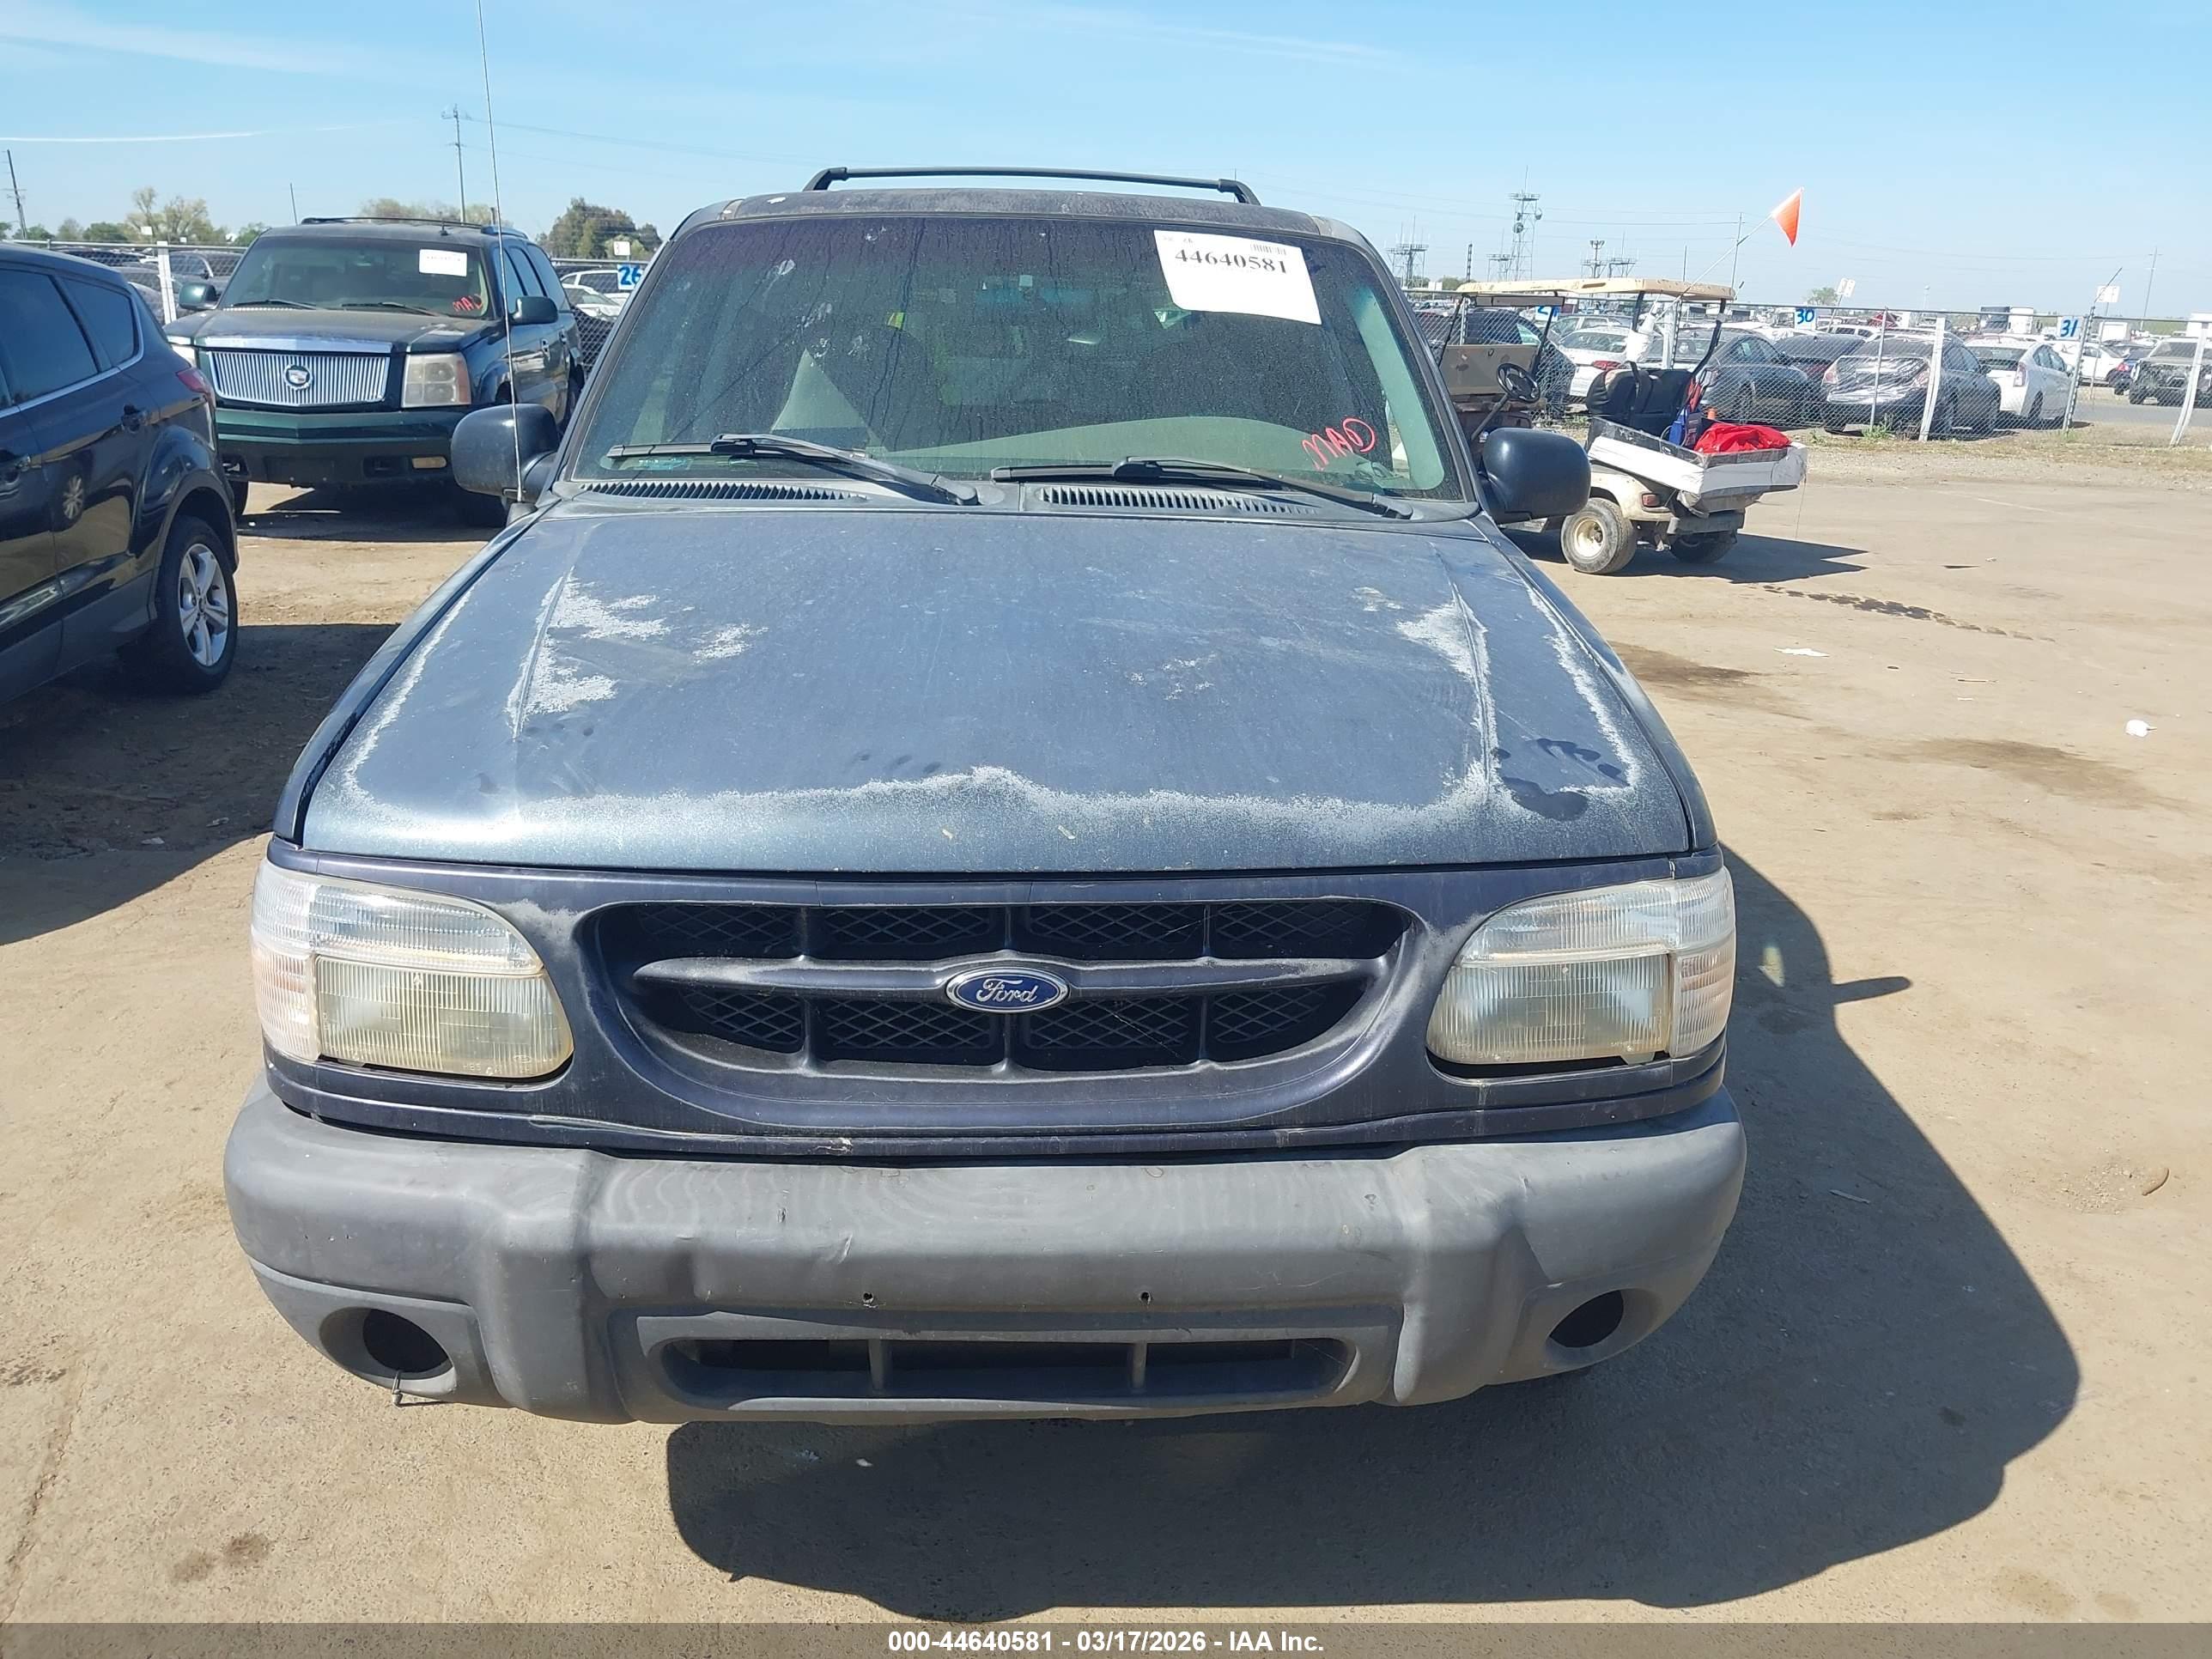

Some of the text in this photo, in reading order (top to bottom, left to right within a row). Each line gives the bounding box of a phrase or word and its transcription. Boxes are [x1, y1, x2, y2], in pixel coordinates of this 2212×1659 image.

[1175, 249, 1287, 274] 44640581
[618, 264, 641, 285] 26
[1796, 308, 1815, 325] 30
[2060, 319, 2078, 337] 31
[975, 978, 1039, 1003] Ford
